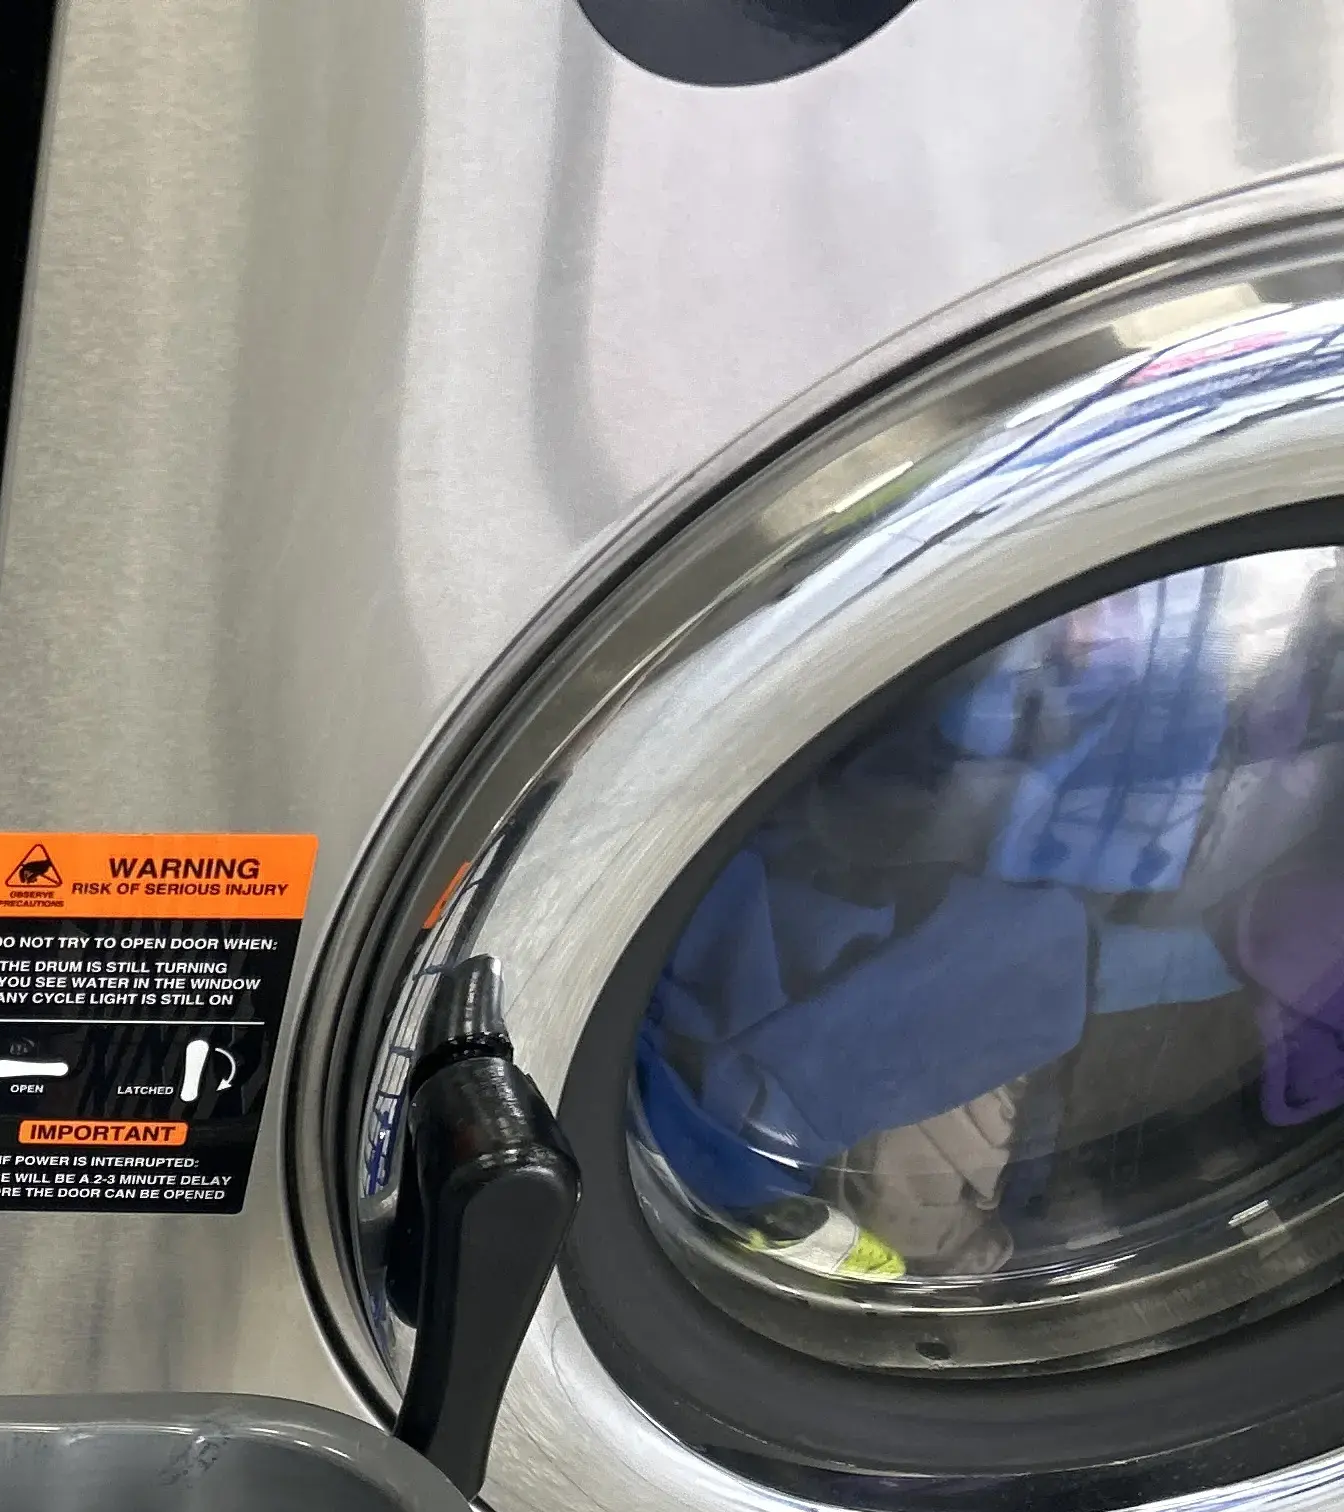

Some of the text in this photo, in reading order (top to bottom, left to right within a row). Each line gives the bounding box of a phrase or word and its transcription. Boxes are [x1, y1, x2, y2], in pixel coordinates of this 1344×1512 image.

[108, 857, 261, 880] WARNING
[9, 890, 55, 900] OBSERVE
[71, 882, 289, 897] RISK OF SERIOUS INJURY
[19, 937, 55, 949] NOT
[57, 937, 91, 949] TRY
[93, 937, 117, 949] TO
[120, 938, 167, 950] OPEN
[169, 938, 220, 950] DOOR
[222, 938, 279, 951] WHEN:
[34, 960, 83, 973] DRUM
[86, 961, 102, 973] IS
[105, 961, 151, 974] STILL
[154, 961, 228, 974] TURNING
[34, 976, 68, 988] SEE
[71, 977, 130, 989] WATER
[133, 977, 151, 989] IN
[153, 978, 186, 990] THE
[189, 978, 262, 990] WINDOW
[32, 992, 87, 1005] CYCLE
[89, 992, 139, 1005] LIGHT
[141, 993, 157, 1005] IS
[160, 993, 205, 1006] STILL
[208, 994, 234, 1006] ON
[10, 1084, 44, 1094] OPEN
[117, 1086, 174, 1096] LATCHED
[30, 1124, 176, 1142] IMPORTANT
[14, 1155, 70, 1166] POWER
[72, 1156, 88, 1167] IS
[90, 1156, 200, 1168] INTERRUPTED:
[14, 1173, 51, 1184] WILL
[54, 1173, 76, 1185] BE
[78, 1173, 90, 1185] A
[92, 1174, 116, 1185] 2-3
[119, 1174, 177, 1186] MINUTE
[180, 1175, 232, 1186] DELAY
[25, 1187, 55, 1198] THE
[57, 1188, 102, 1198] DOOR
[104, 1188, 136, 1199] CAN
[139, 1189, 161, 1199] BE
[163, 1189, 225, 1200] OPENED
